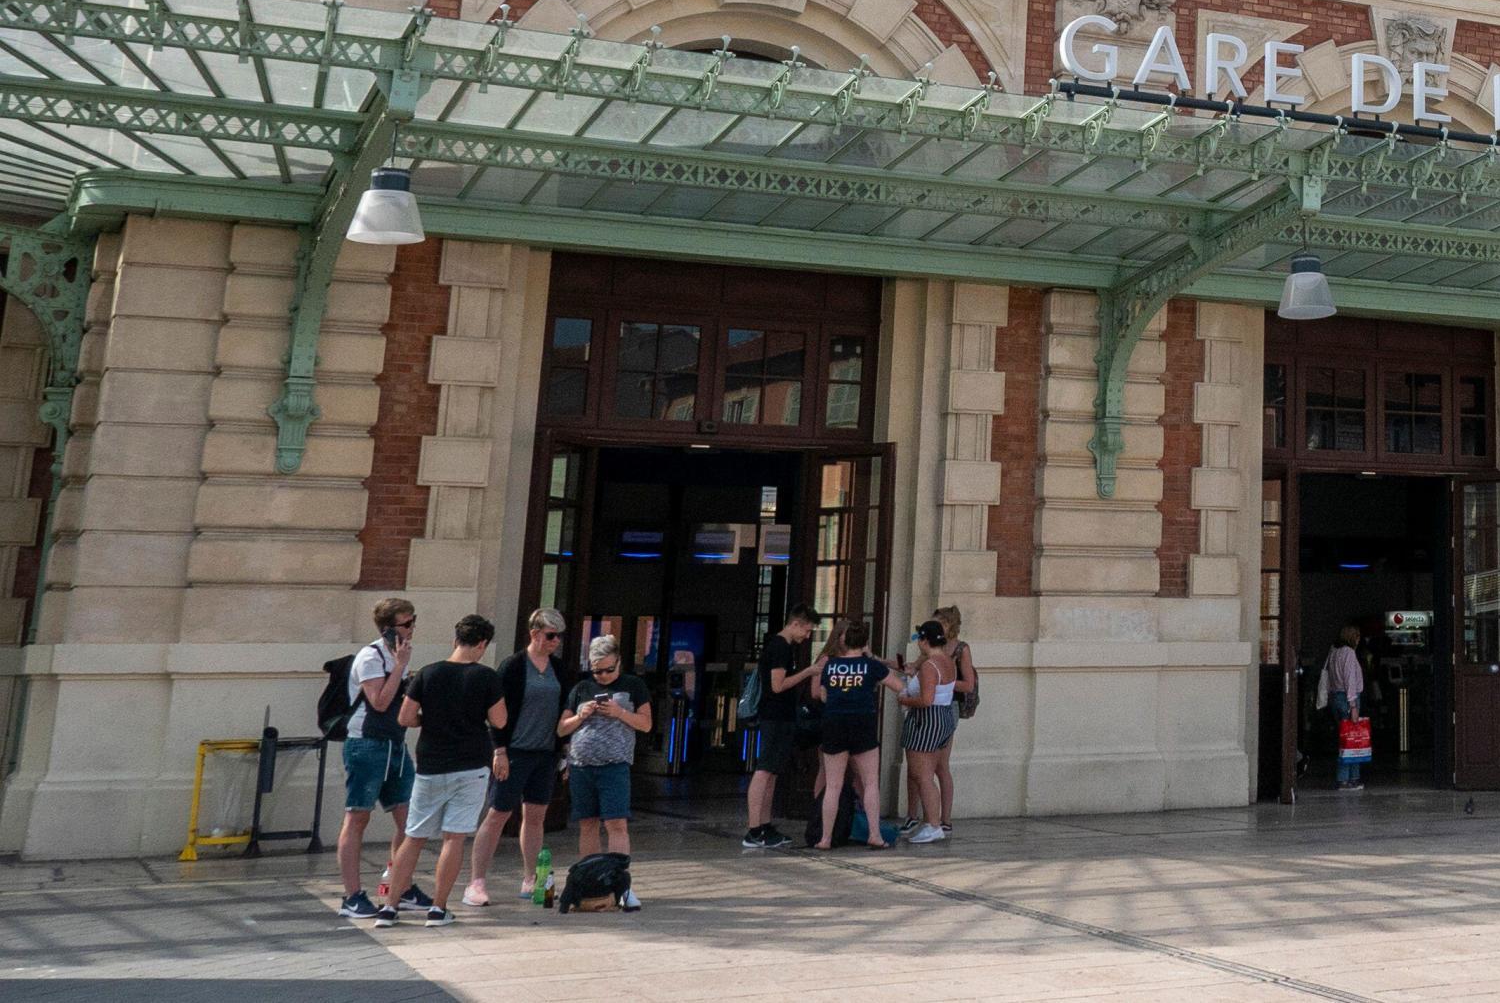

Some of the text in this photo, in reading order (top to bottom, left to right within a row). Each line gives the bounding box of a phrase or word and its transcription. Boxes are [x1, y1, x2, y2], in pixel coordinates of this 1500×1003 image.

[1060, 14, 1305, 104] GARE
[1352, 52, 1451, 122] DE
[827, 663, 868, 675] HOLLI
[830, 675, 863, 687] STER
